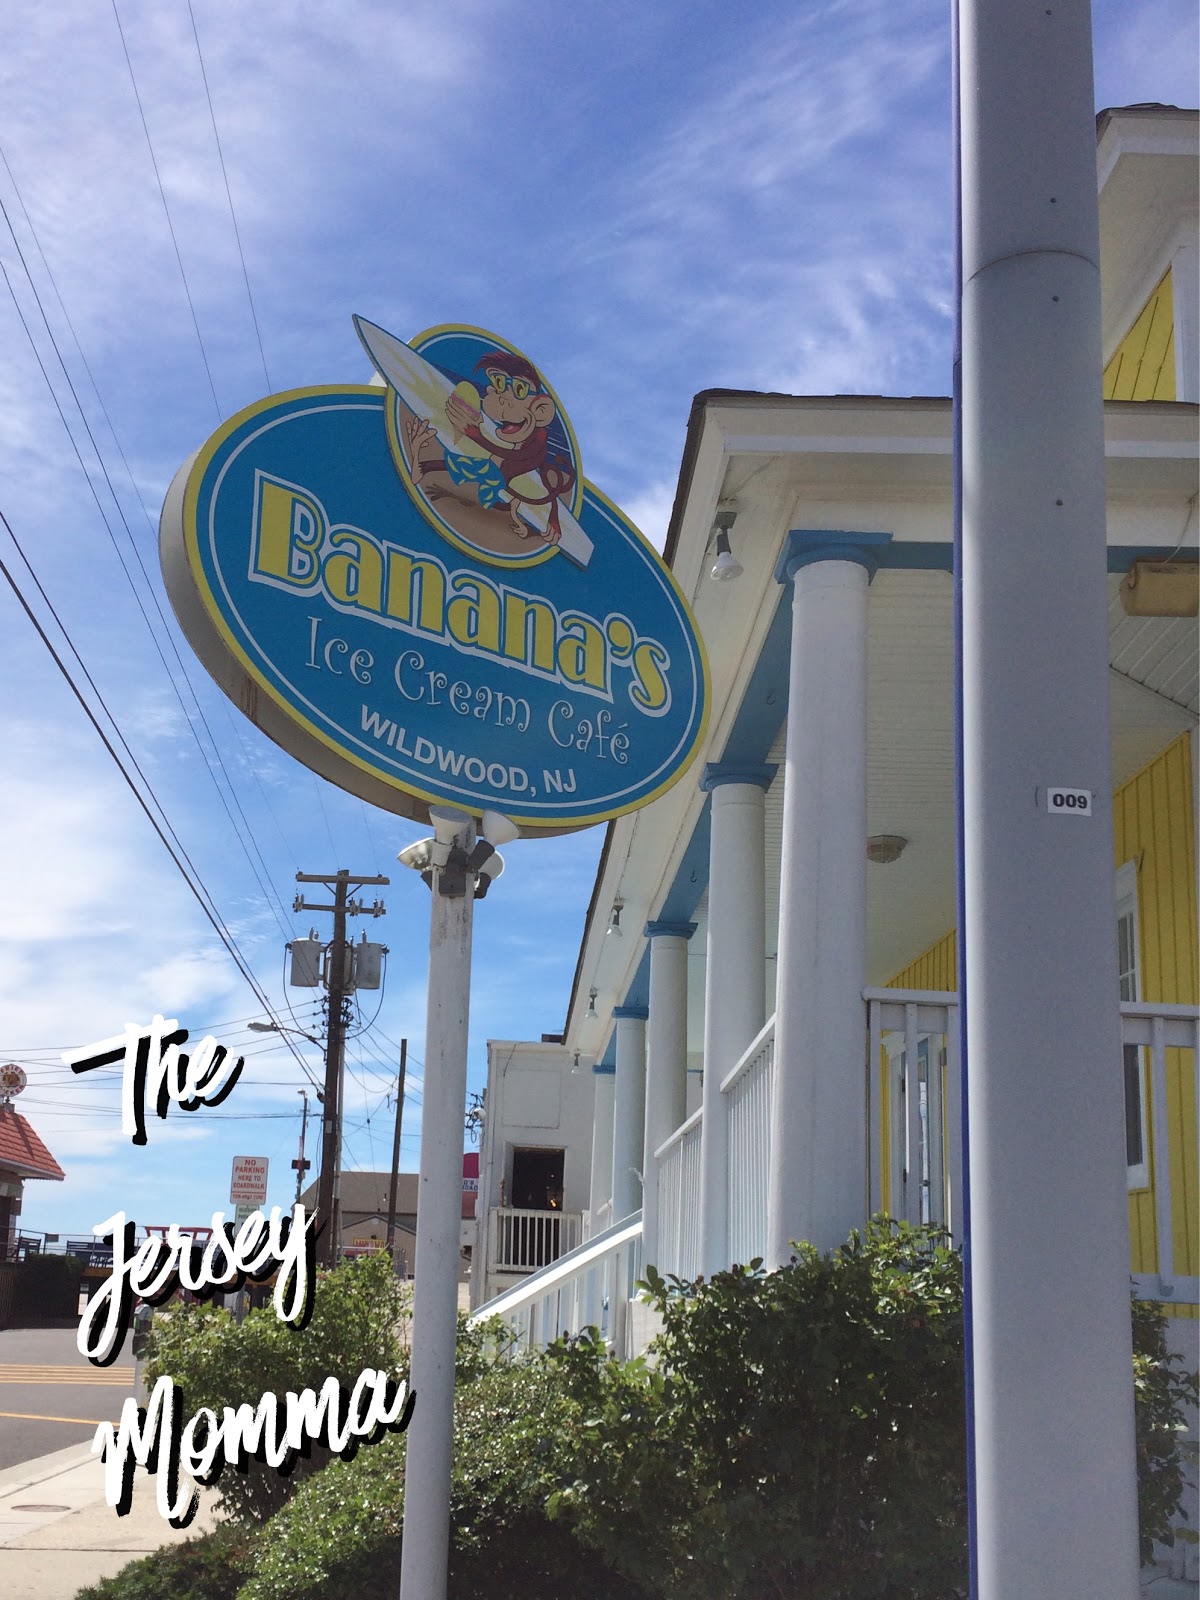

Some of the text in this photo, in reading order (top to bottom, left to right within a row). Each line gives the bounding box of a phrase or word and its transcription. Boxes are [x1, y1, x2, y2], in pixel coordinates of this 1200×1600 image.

[249, 468, 671, 717] Banana's
[306, 616, 630, 765] Ice Cream Café
[361, 704, 577, 797] WILDWOOD, NJ
[1052, 793, 1088, 809] 009
[233, 1182, 265, 1190] BOARDWALK
[235, 1166, 265, 1174] PARKING
